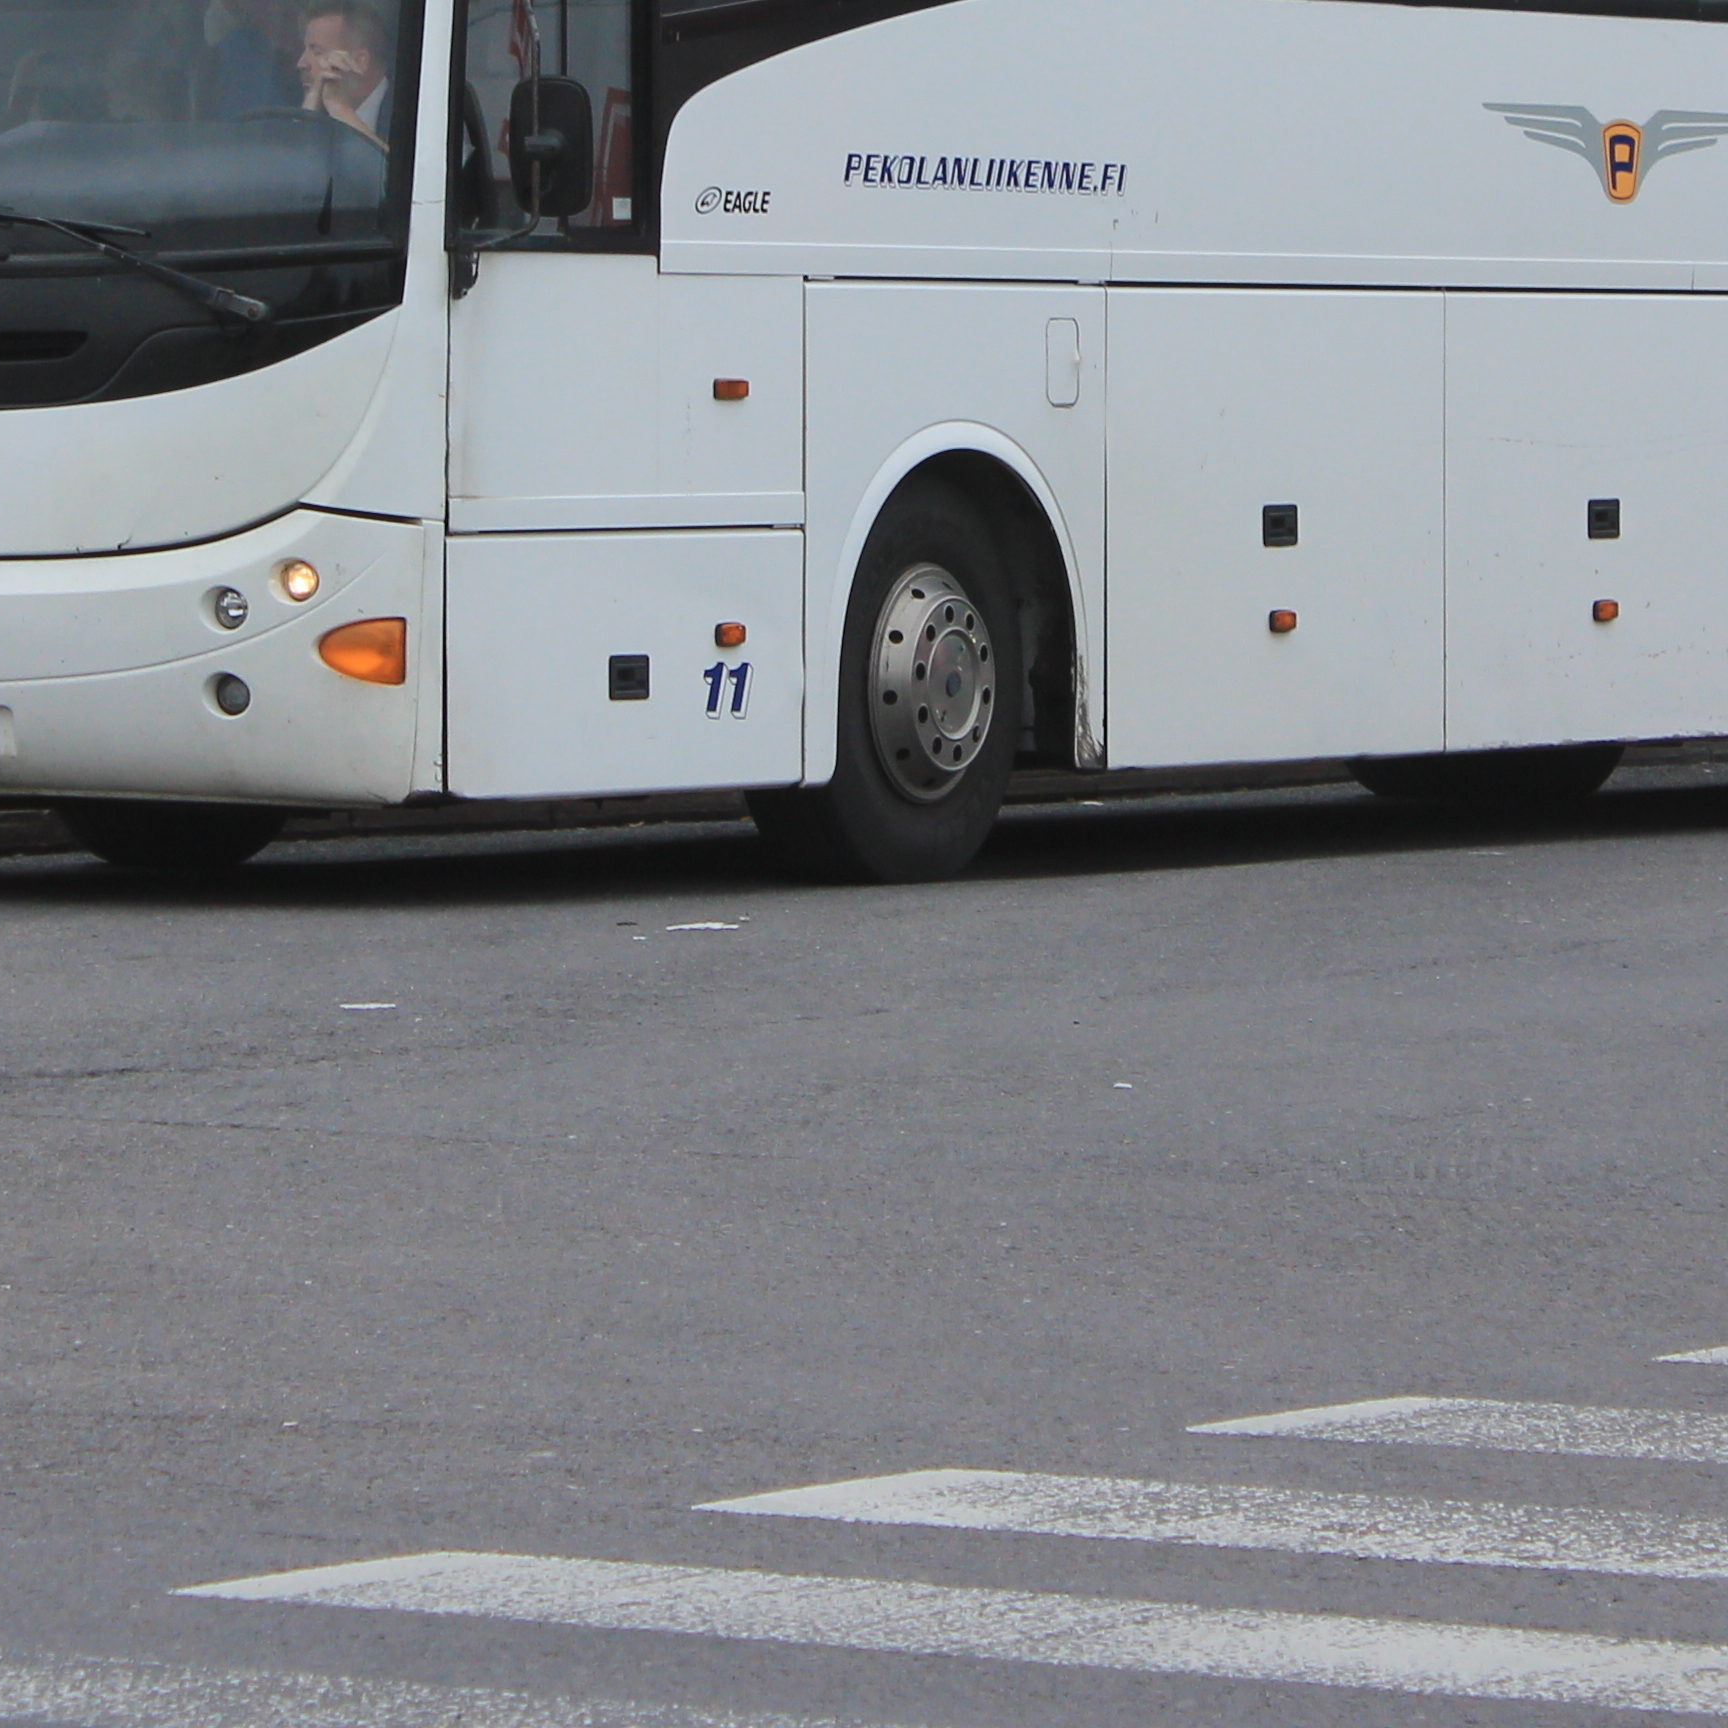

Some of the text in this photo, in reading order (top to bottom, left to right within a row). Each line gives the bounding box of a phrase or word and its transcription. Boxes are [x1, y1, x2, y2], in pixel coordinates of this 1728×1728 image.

[843, 152, 1128, 196] PEKOLANLIIKENNE.FI
[723, 190, 771, 213] EAGLE
[703, 662, 754, 720] 11
